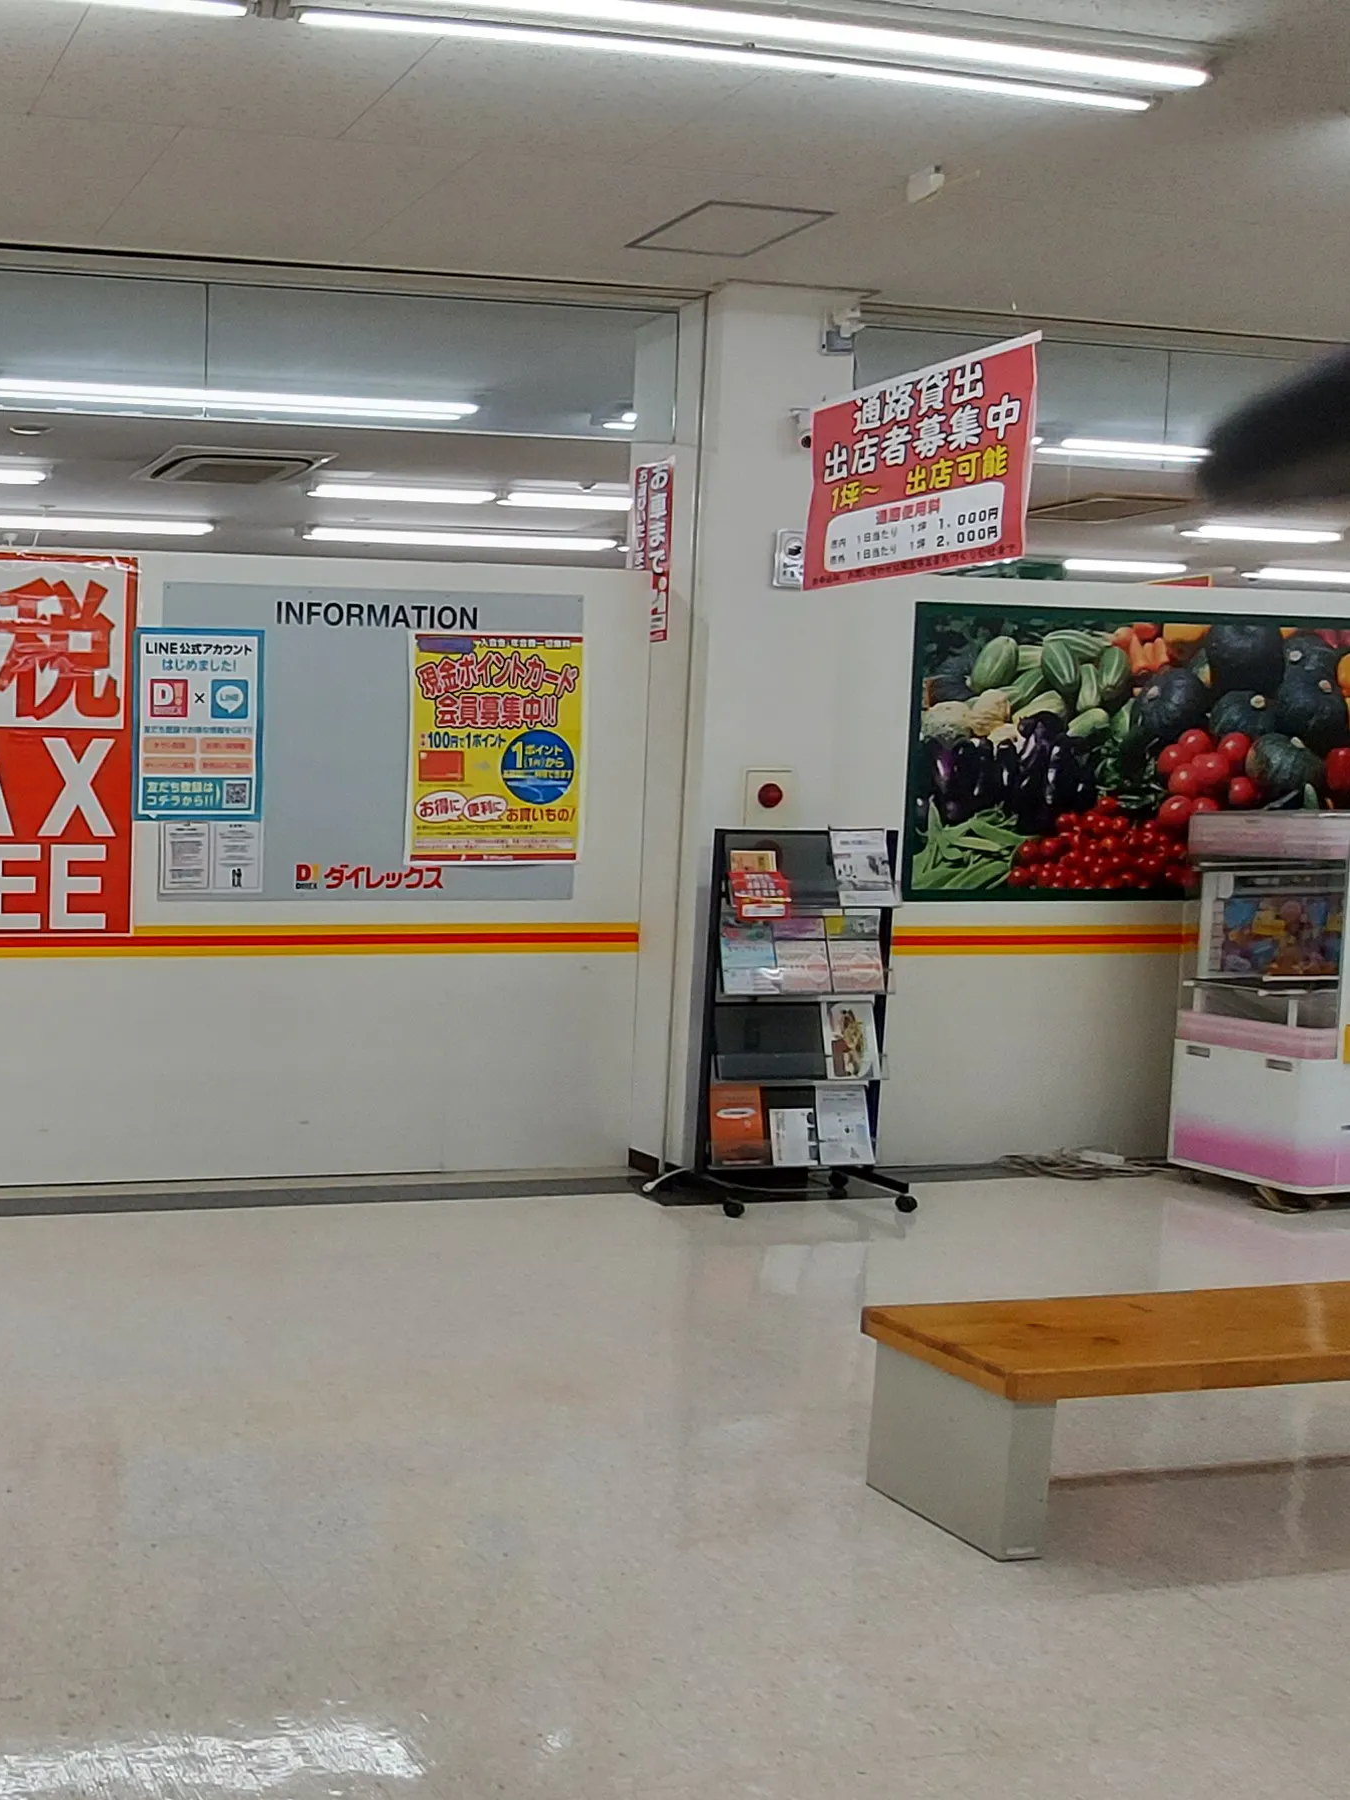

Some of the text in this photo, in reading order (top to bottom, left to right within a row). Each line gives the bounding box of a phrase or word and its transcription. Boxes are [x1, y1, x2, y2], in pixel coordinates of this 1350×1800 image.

[853, 361, 984, 435] 通路貸出
[822, 394, 1021, 484] 出店者募集中
[905, 445, 1008, 496] 出店可能
[276, 601, 478, 630] INFORMATION
[417, 651, 580, 697] 現金ポイントカード
[436, 693, 558, 728] 会員募集中!!
[419, 797, 576, 822] お得に 便利に お買いもの!
[324, 864, 444, 889] ダイレックス
